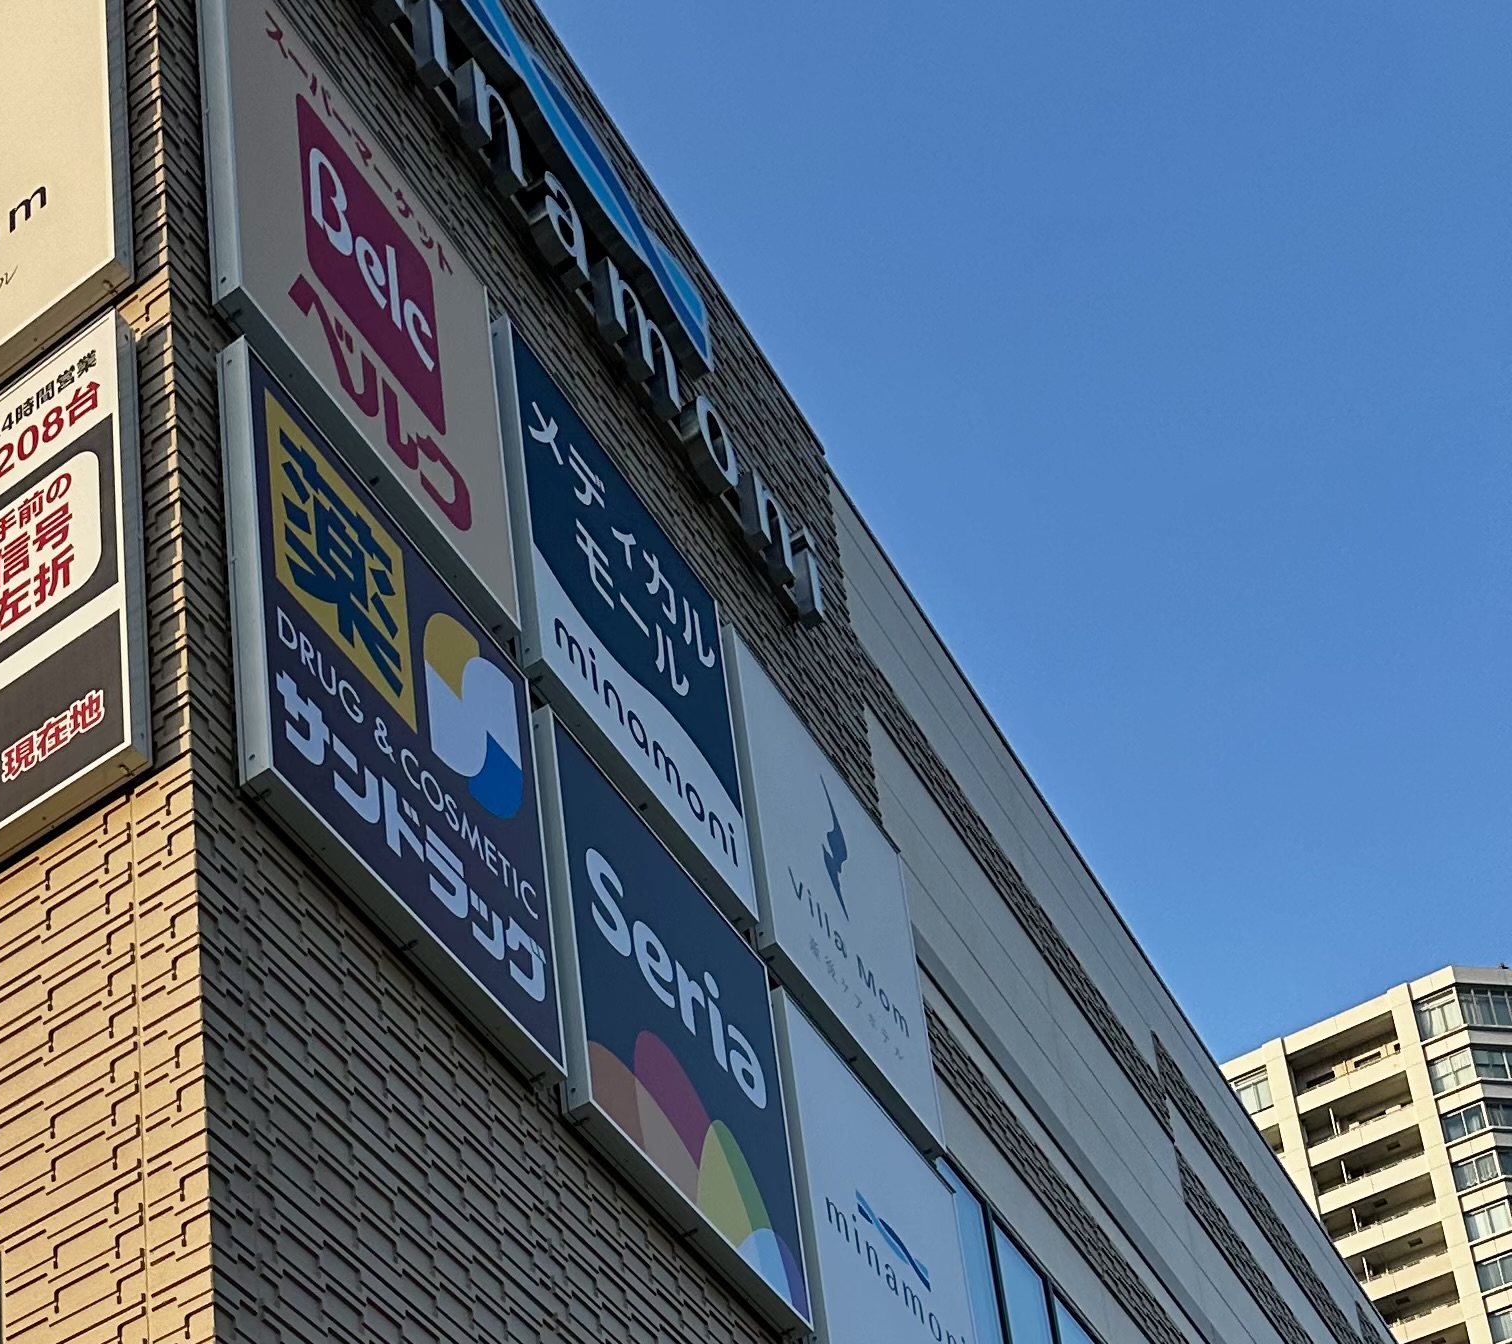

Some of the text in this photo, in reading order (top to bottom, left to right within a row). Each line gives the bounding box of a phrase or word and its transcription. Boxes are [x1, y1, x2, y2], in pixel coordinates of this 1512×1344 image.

[263, 22, 455, 275] スーパーマーケット
[309, 147, 437, 372] Belc
[288, 274, 471, 532] ベルク
[393, 0, 824, 627] inamoni
[279, 428, 402, 697] 薬
[529, 400, 716, 669] メディカル
[576, 519, 690, 697] モール
[1, 688, 105, 783] 現在地
[274, 668, 546, 1002] サンドラッグ
[276, 607, 539, 920] DRUG & COSMETIC
[555, 616, 738, 867] minamoni
[585, 846, 768, 1110] Seria
[787, 866, 909, 1038] Villa Mom
